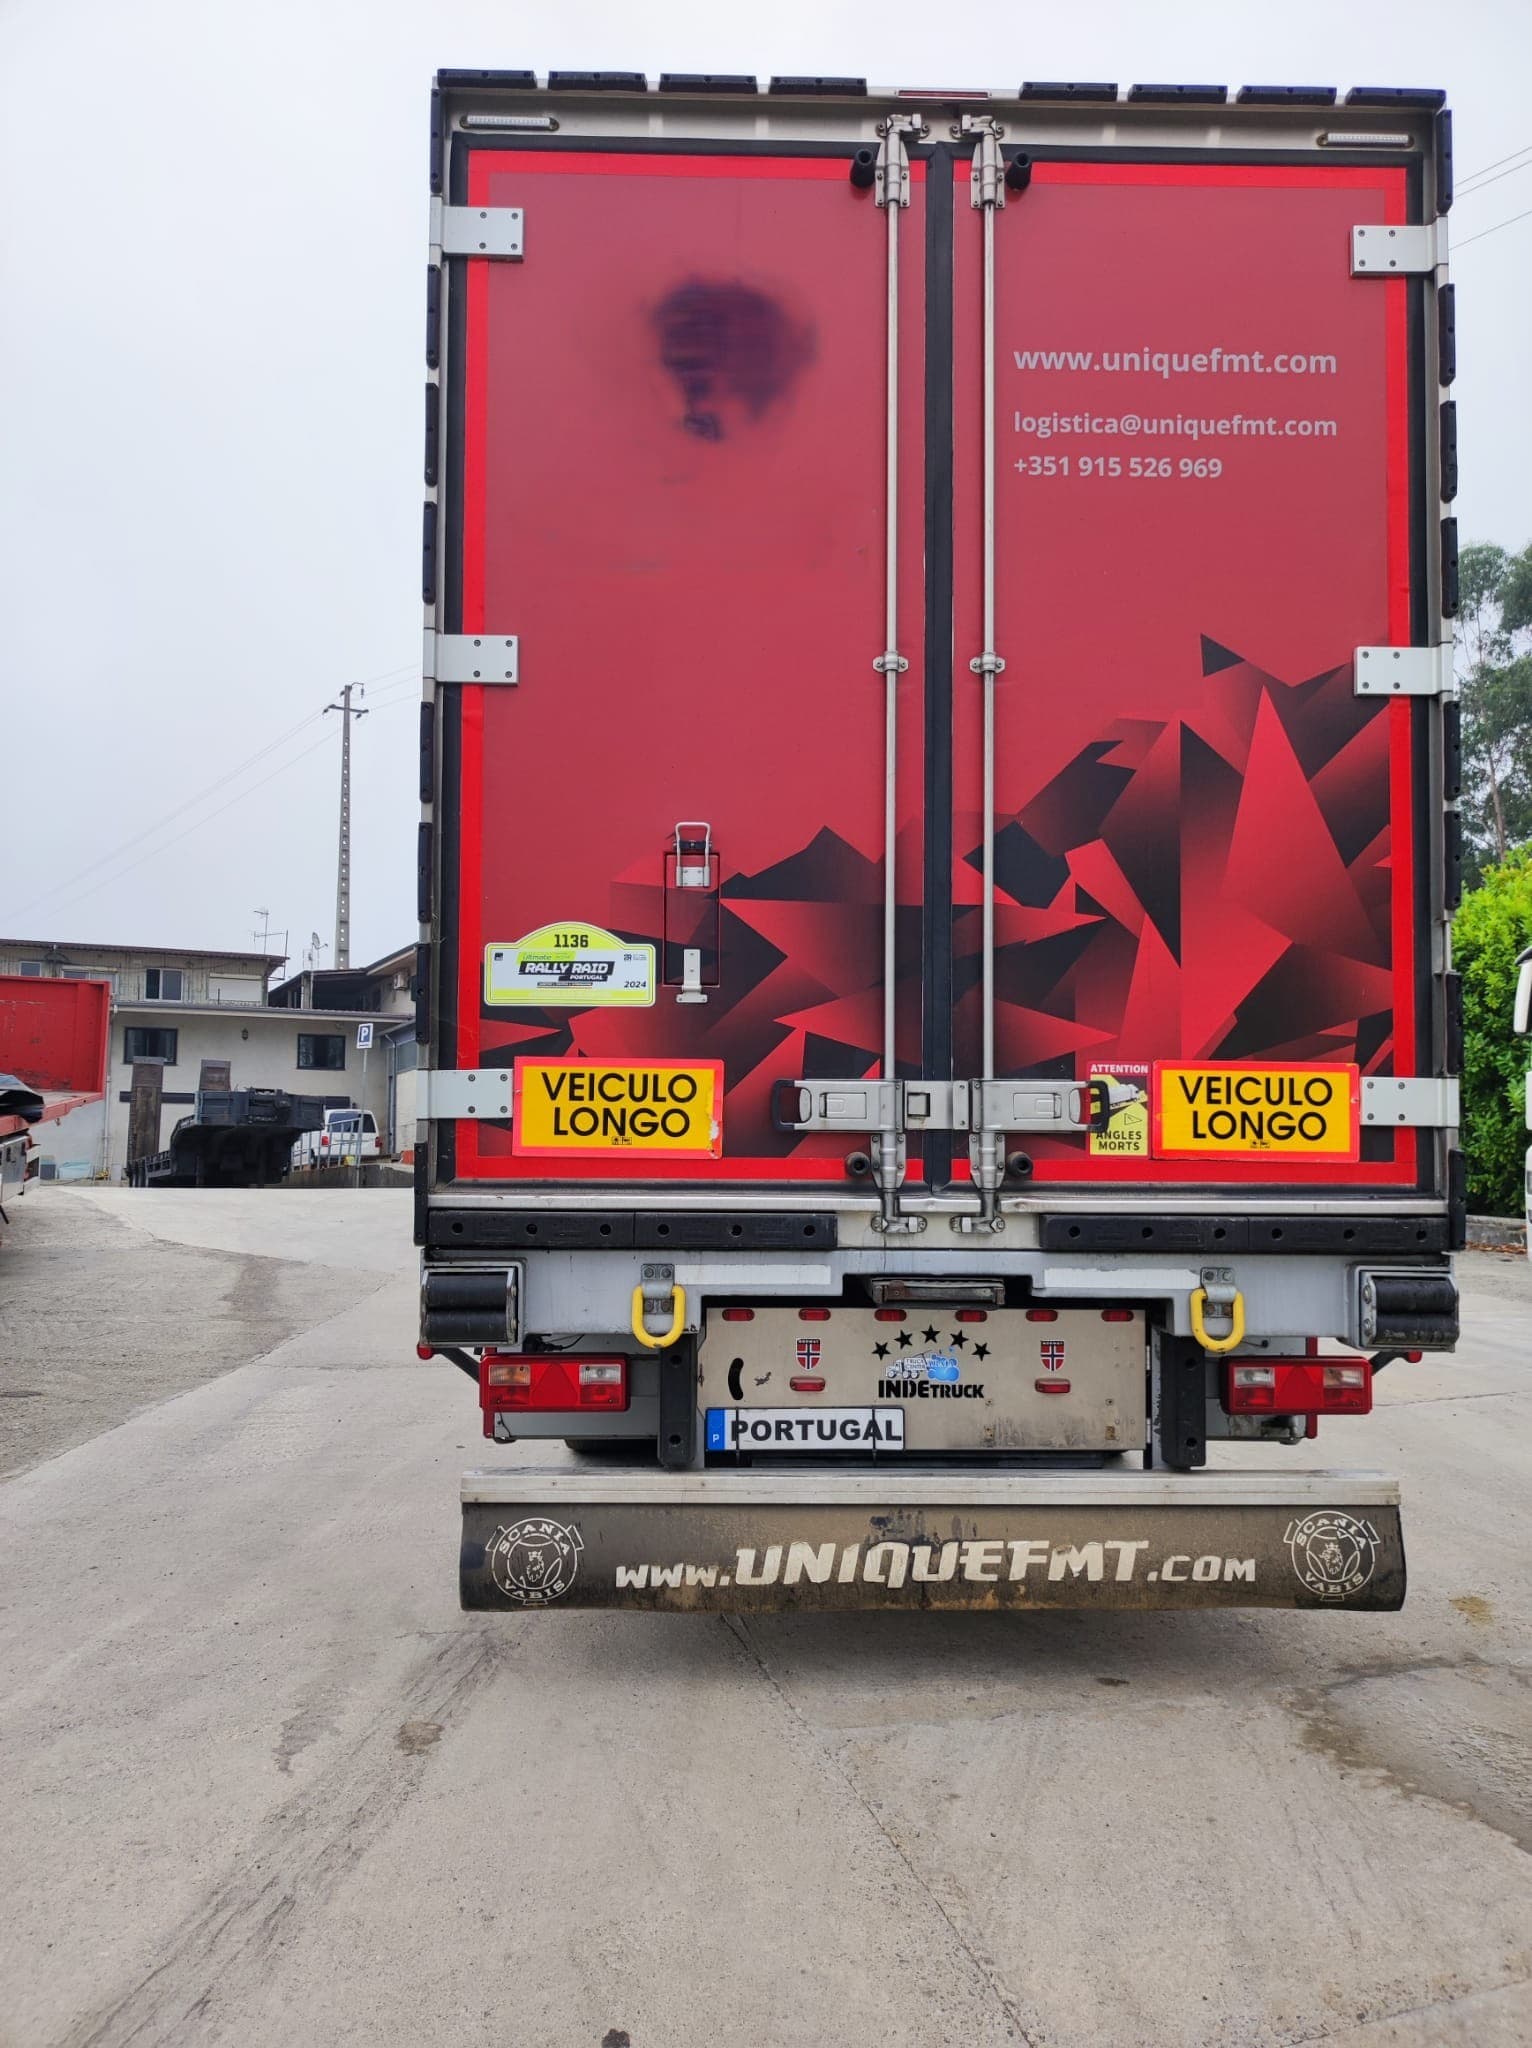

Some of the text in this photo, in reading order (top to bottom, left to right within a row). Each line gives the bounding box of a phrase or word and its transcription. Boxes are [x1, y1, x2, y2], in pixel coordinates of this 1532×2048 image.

[1013, 347, 1338, 379] www.uniquefmt.com
[1014, 411, 1338, 441] logistica@uniquefmt.com
[1013, 456, 1223, 478] +351 915 526 969
[554, 934, 589, 948] 1136
[525, 962, 609, 974] RALLY RAID
[361, 1027, 369, 1041] P
[1091, 1064, 1149, 1073] ATTENTION
[541, 1072, 697, 1103] VEICULO
[1178, 1076, 1333, 1107] VEICULO
[553, 1107, 691, 1138] LONGO
[1192, 1110, 1327, 1141] LONGO
[1096, 1130, 1142, 1140] ANGLES
[1098, 1141, 1140, 1151] MORTS
[878, 1380, 985, 1398] INDETRUCK
[712, 1433, 720, 1443] P
[731, 1418, 902, 1442] PORTUGAL
[499, 1522, 570, 1556] SCANIA
[1296, 1518, 1367, 1550] SCANIA
[505, 1579, 566, 1599] VABIS
[1305, 1570, 1365, 1593] VABIS
